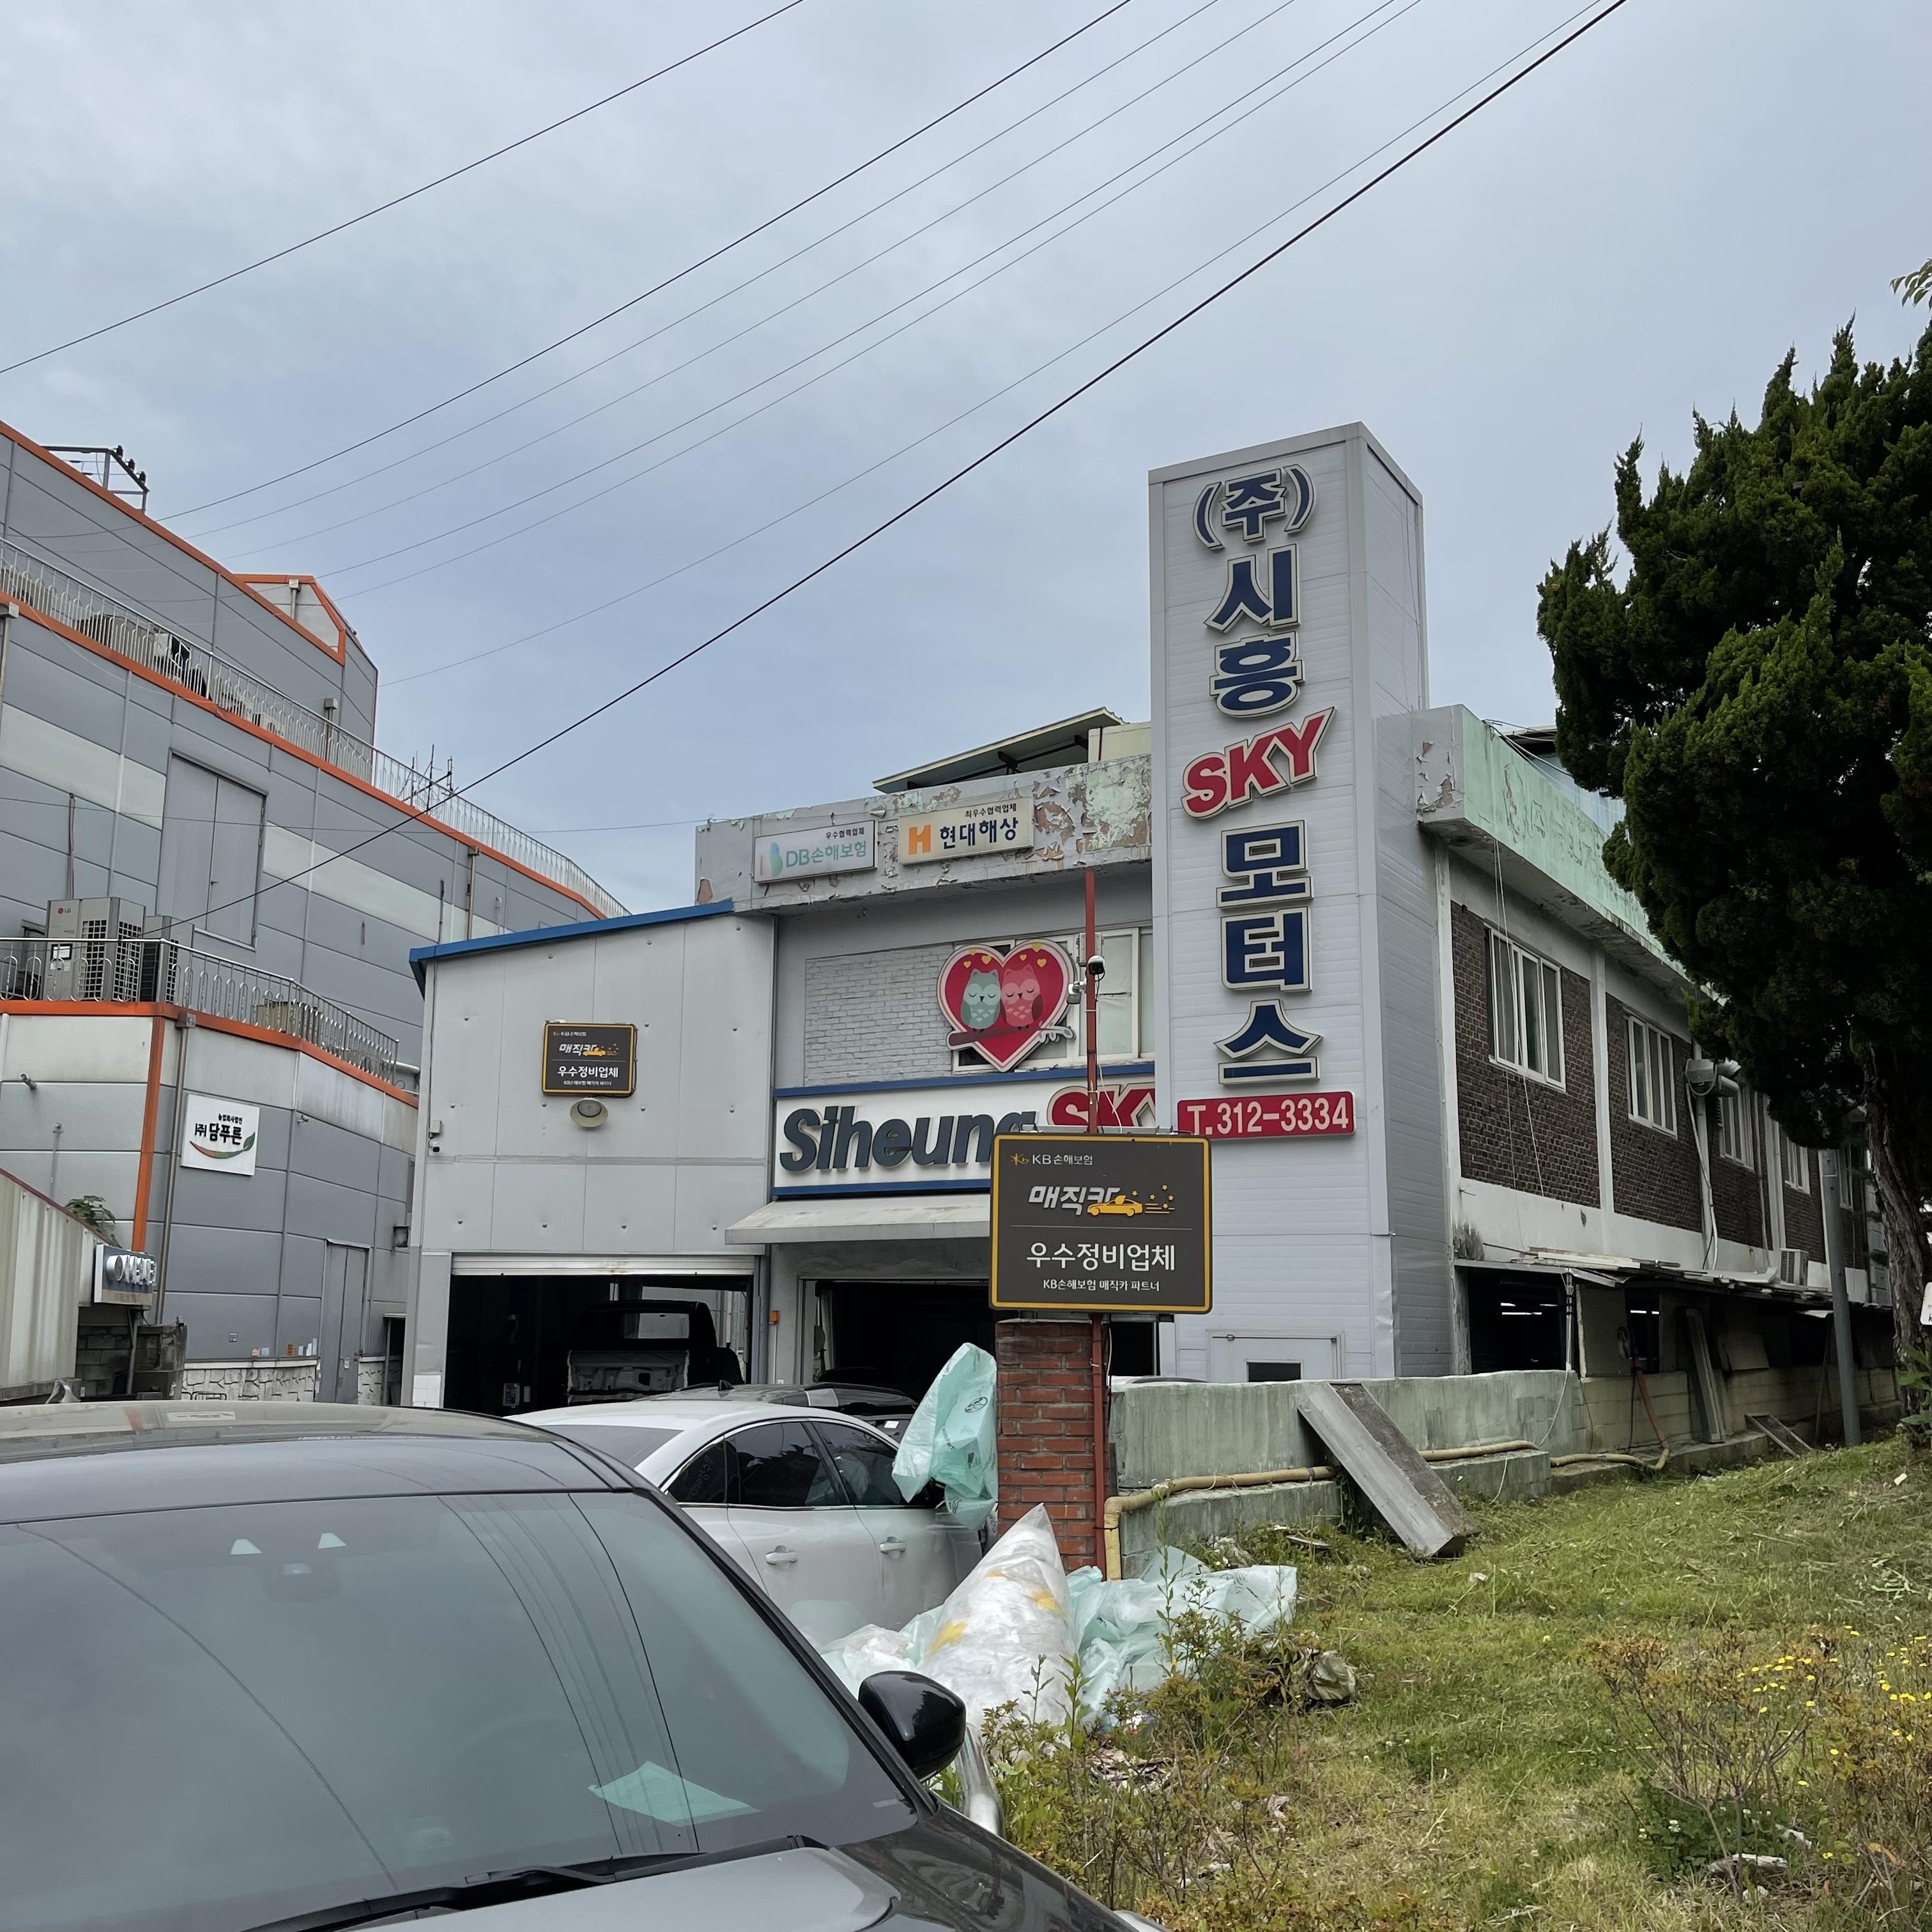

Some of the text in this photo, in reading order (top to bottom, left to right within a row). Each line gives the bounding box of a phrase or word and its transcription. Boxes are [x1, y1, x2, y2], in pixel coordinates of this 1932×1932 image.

[1181, 707, 1335, 819] SKY
[965, 803, 1016, 818] 최우수협력업체
[825, 827, 864, 840] 우수협력업체
[940, 816, 1018, 850] 현대해상
[786, 840, 866, 868] DB손해보험
[1213, 820, 1323, 1085] 모터스
[557, 1066, 618, 1078] 우수정비업체
[1187, 1097, 1349, 1135] T.312-3334
[1027, 1243, 1176, 1271] 우수정비업체
[1043, 1279, 1160, 1291] KB손해보험 매직카 파트너
